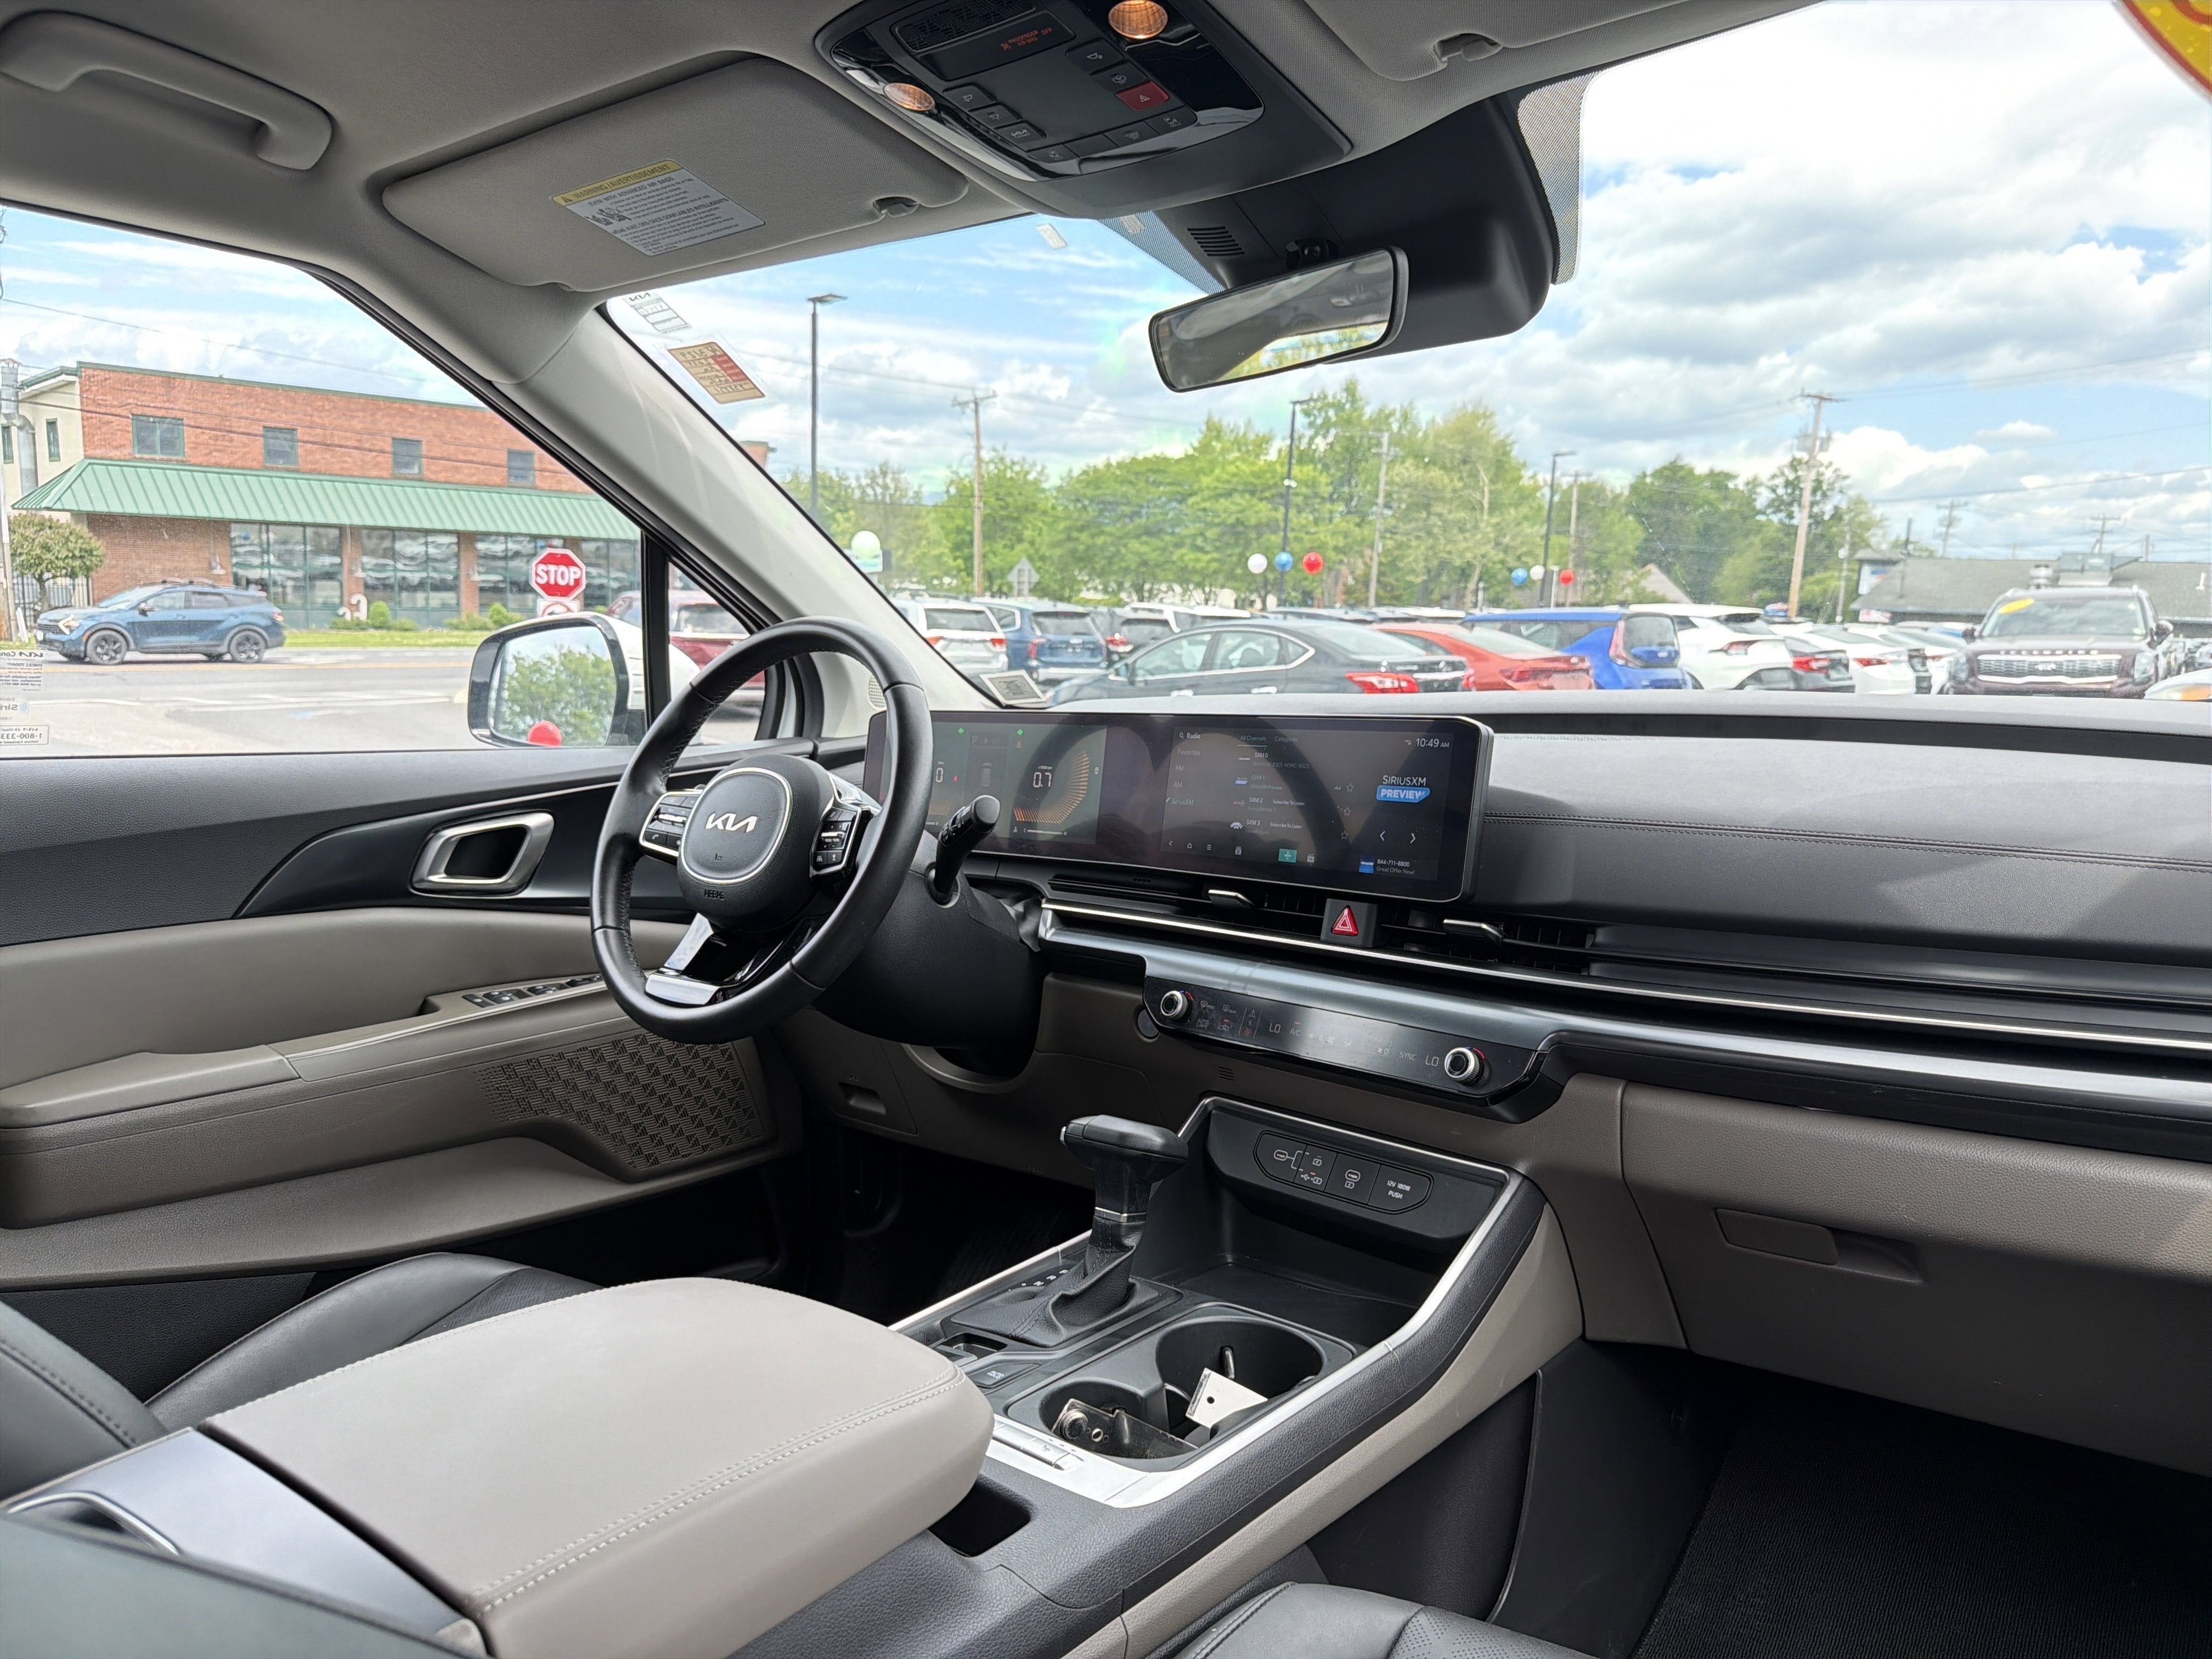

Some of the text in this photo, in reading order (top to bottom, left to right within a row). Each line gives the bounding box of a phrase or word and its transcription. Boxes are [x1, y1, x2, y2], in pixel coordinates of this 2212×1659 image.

[536, 563, 581, 586] STOP
[1416, 738, 1439, 748] 10:49
[935, 768, 944, 782] 0
[1033, 772, 1052, 788] 0.7
[1383, 775, 1426, 786] SIRIUSXM
[1381, 789, 1425, 799] PREVIEW
[706, 813, 758, 833] KIA
[1269, 1023, 1281, 1033] LO
[1400, 1051, 1417, 1061] SYNC
[1425, 1055, 1439, 1067] LO
[1397, 1183, 1410, 1192] 180W
[1388, 1190, 1403, 1199] PUSH
